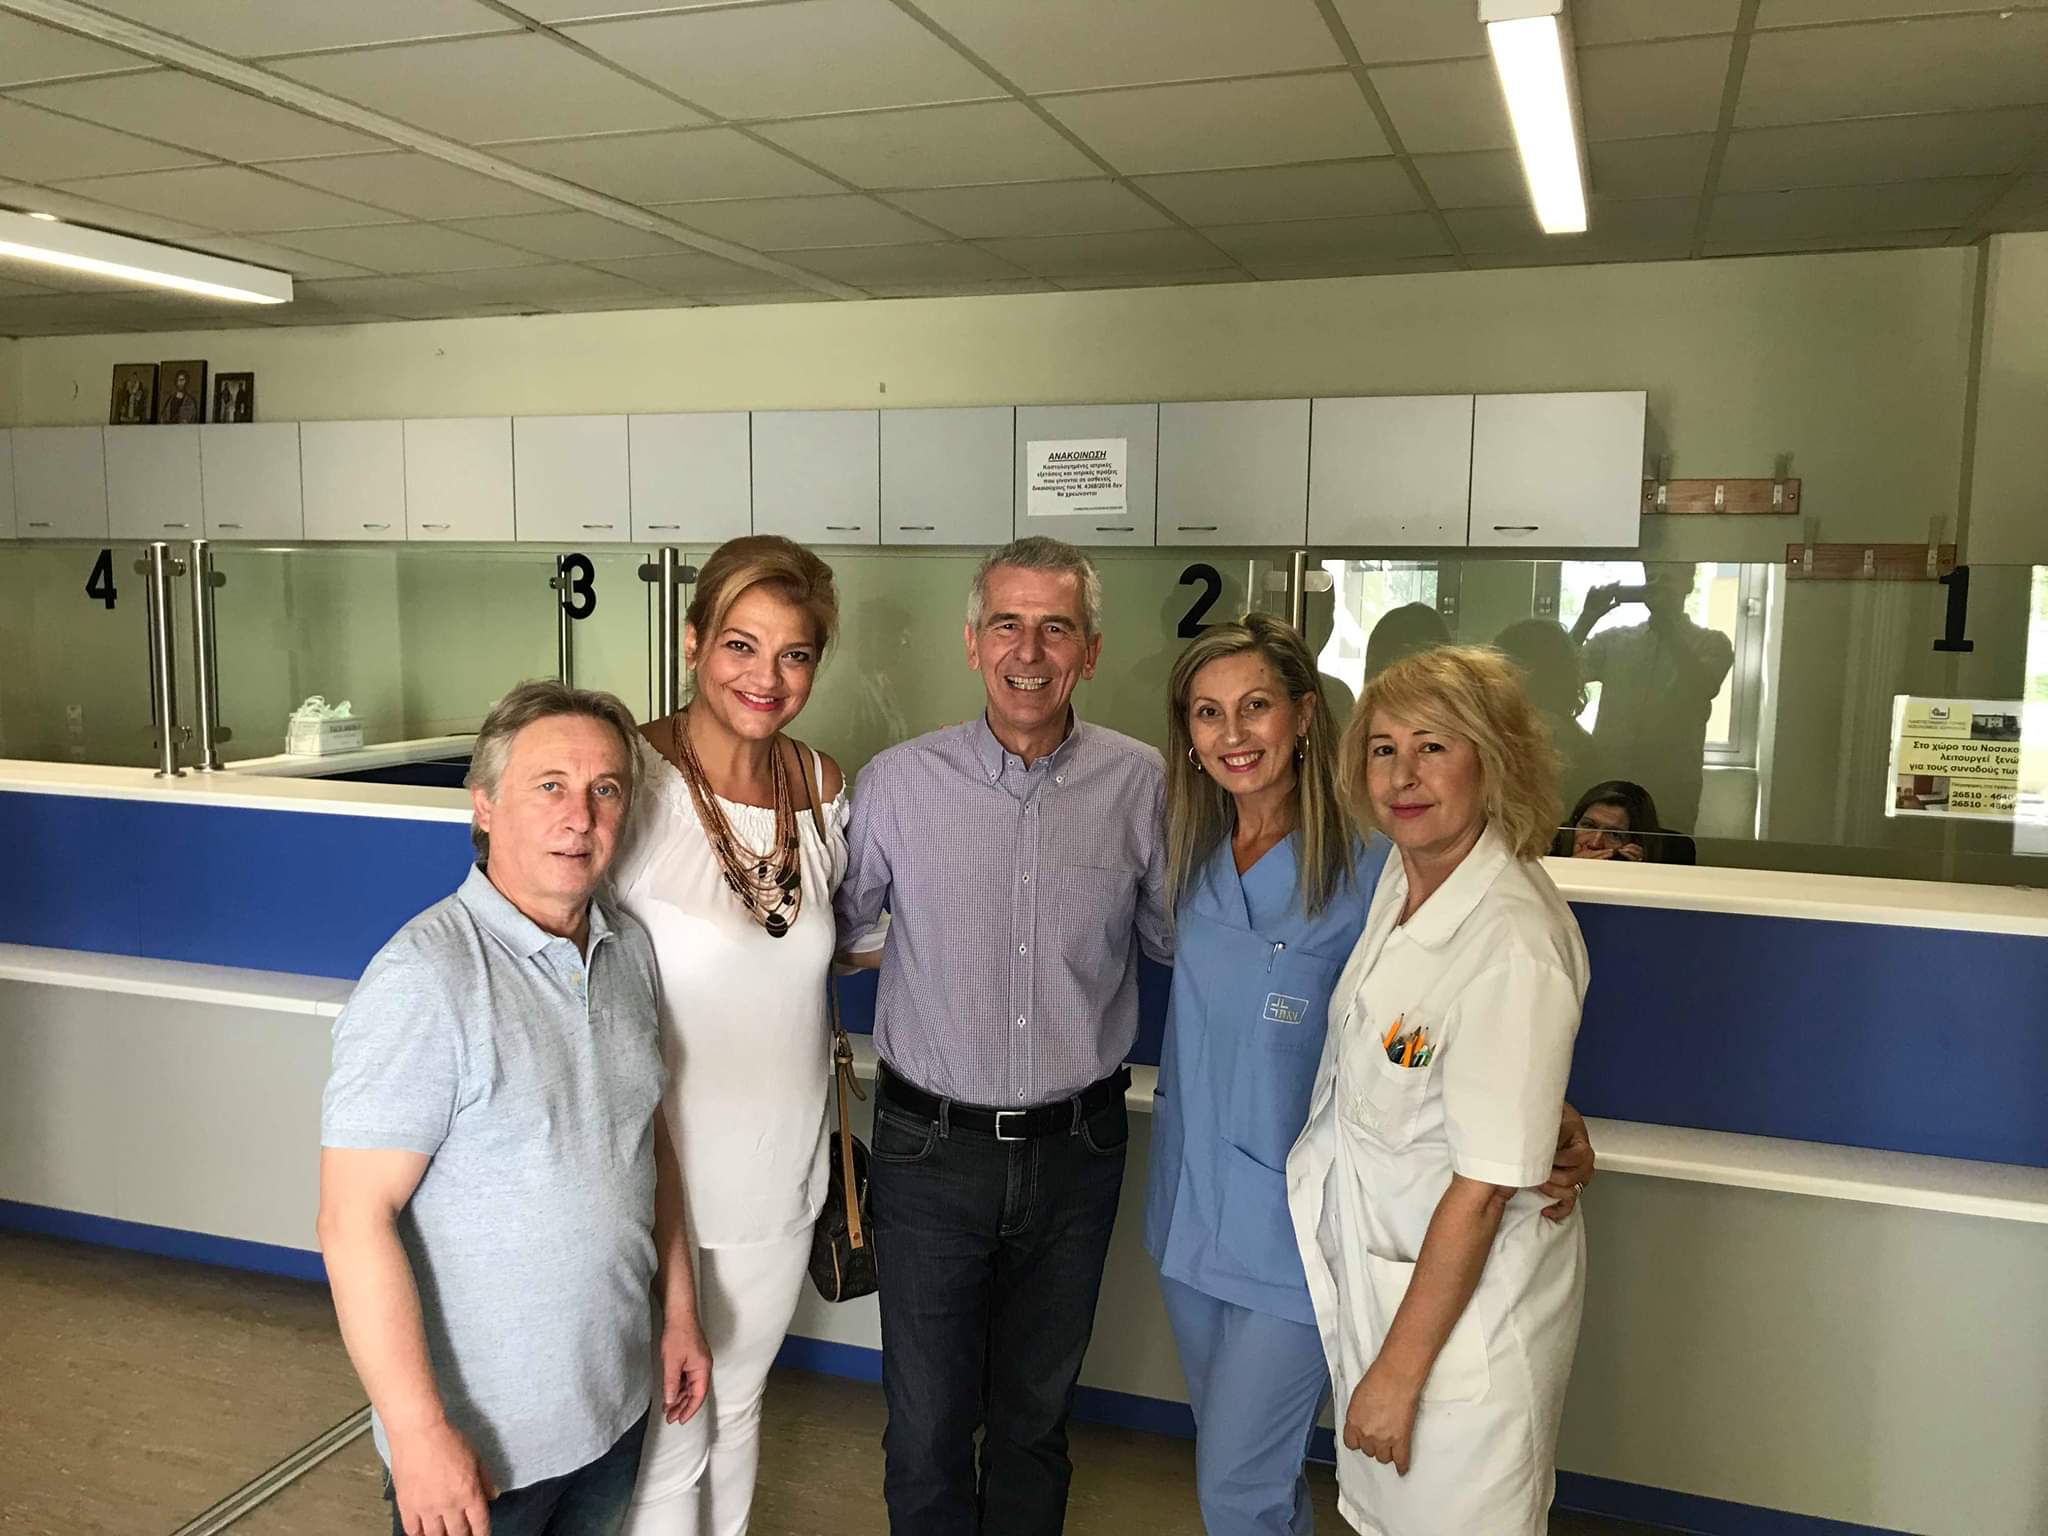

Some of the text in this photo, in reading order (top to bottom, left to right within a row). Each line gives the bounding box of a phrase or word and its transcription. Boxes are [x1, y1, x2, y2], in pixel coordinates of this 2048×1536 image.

[1048, 450, 1107, 461] ΑΝΑΚΟΙΝΩΣΗ
[86, 549, 117, 609] 4
[561, 553, 596, 620] 3
[1178, 563, 1222, 638] 2
[1934, 566, 1973, 652] 1
[1913, 741, 1930, 749] Στο
[1932, 742, 1959, 751] χώρο
[1962, 744, 1978, 752] του
[1940, 753, 1991, 764] λειτουργεί
[1909, 763, 1924, 771] για
[1927, 764, 1948, 773] τους
[1950, 764, 2000, 775] συνοδούς
[1952, 791, 1982, 799] 26510
[1951, 800, 1982, 809] 26510
